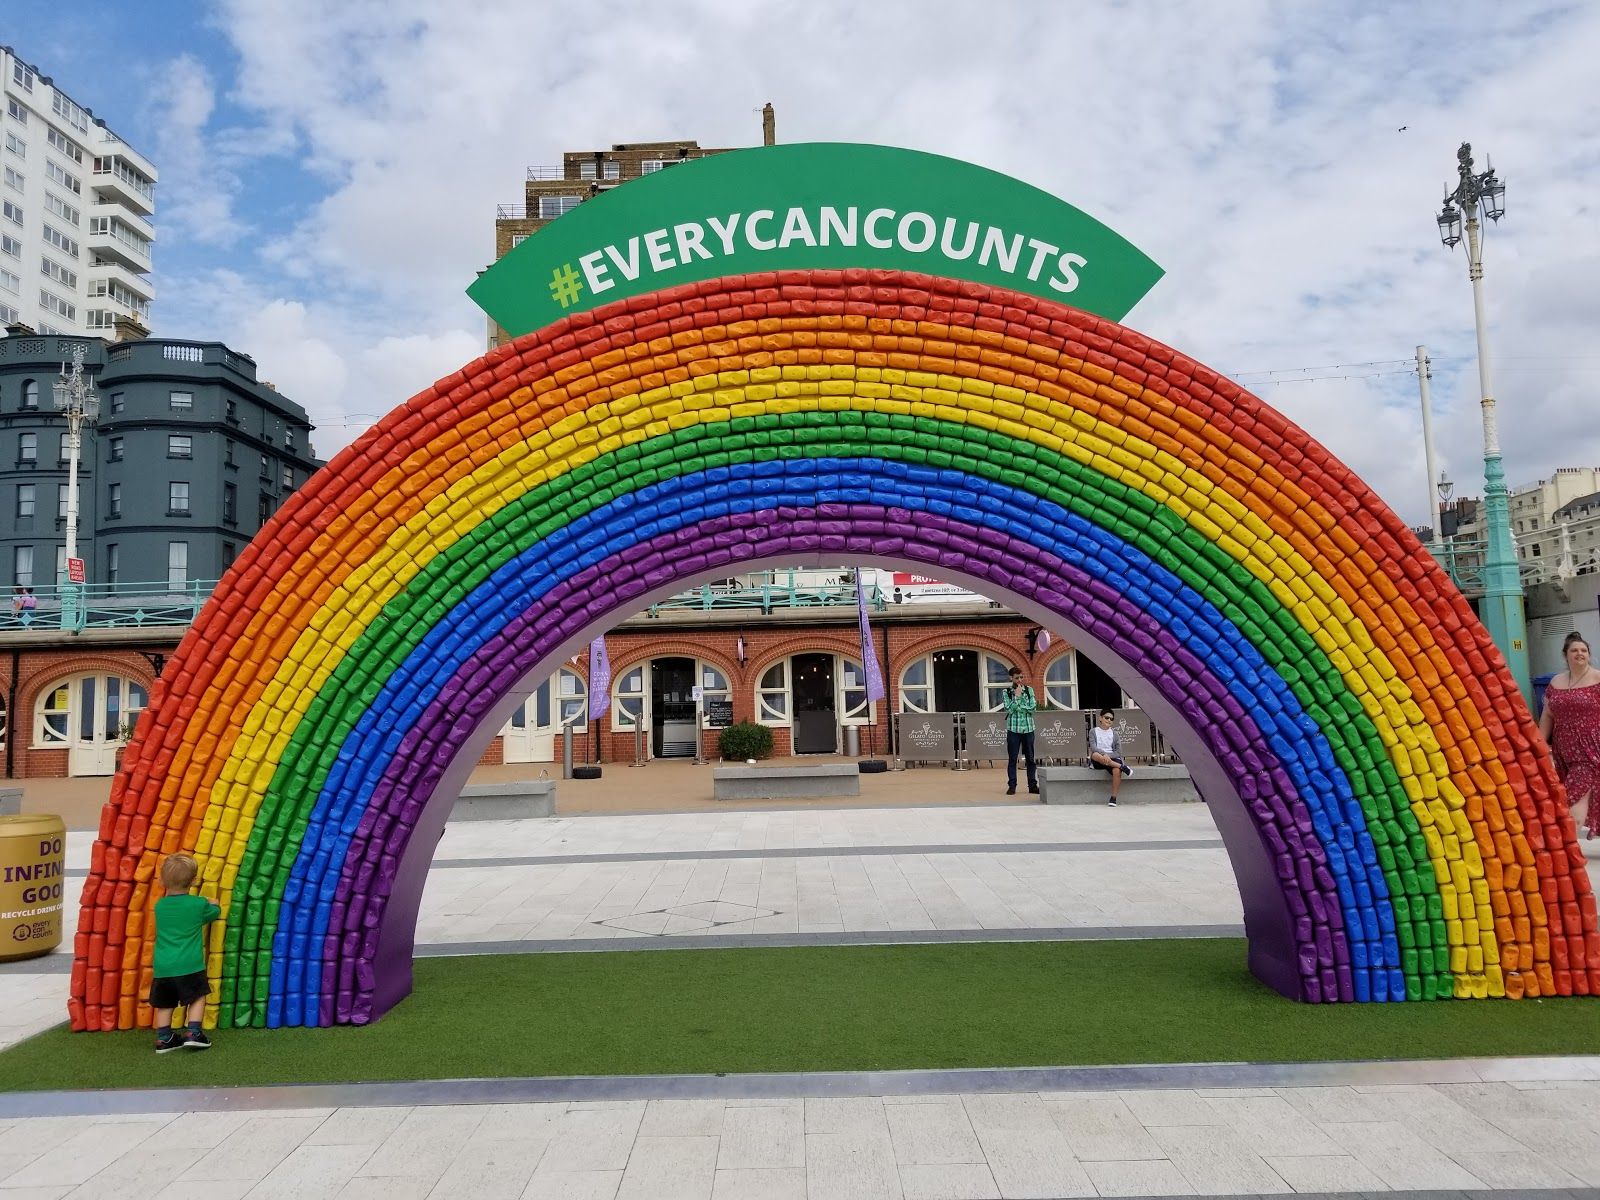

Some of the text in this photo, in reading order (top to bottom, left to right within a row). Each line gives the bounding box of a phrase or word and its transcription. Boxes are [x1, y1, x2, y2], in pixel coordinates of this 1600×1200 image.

[548, 206, 1088, 309] #EVERYCANCOUNTS
[40, 838, 62, 856] DO
[1, 908, 36, 919] RECYCLE
[36, 904, 57, 915] DRINK
[32, 920, 51, 928] every
[32, 926, 46, 934] can
[32, 928, 53, 939] counts
